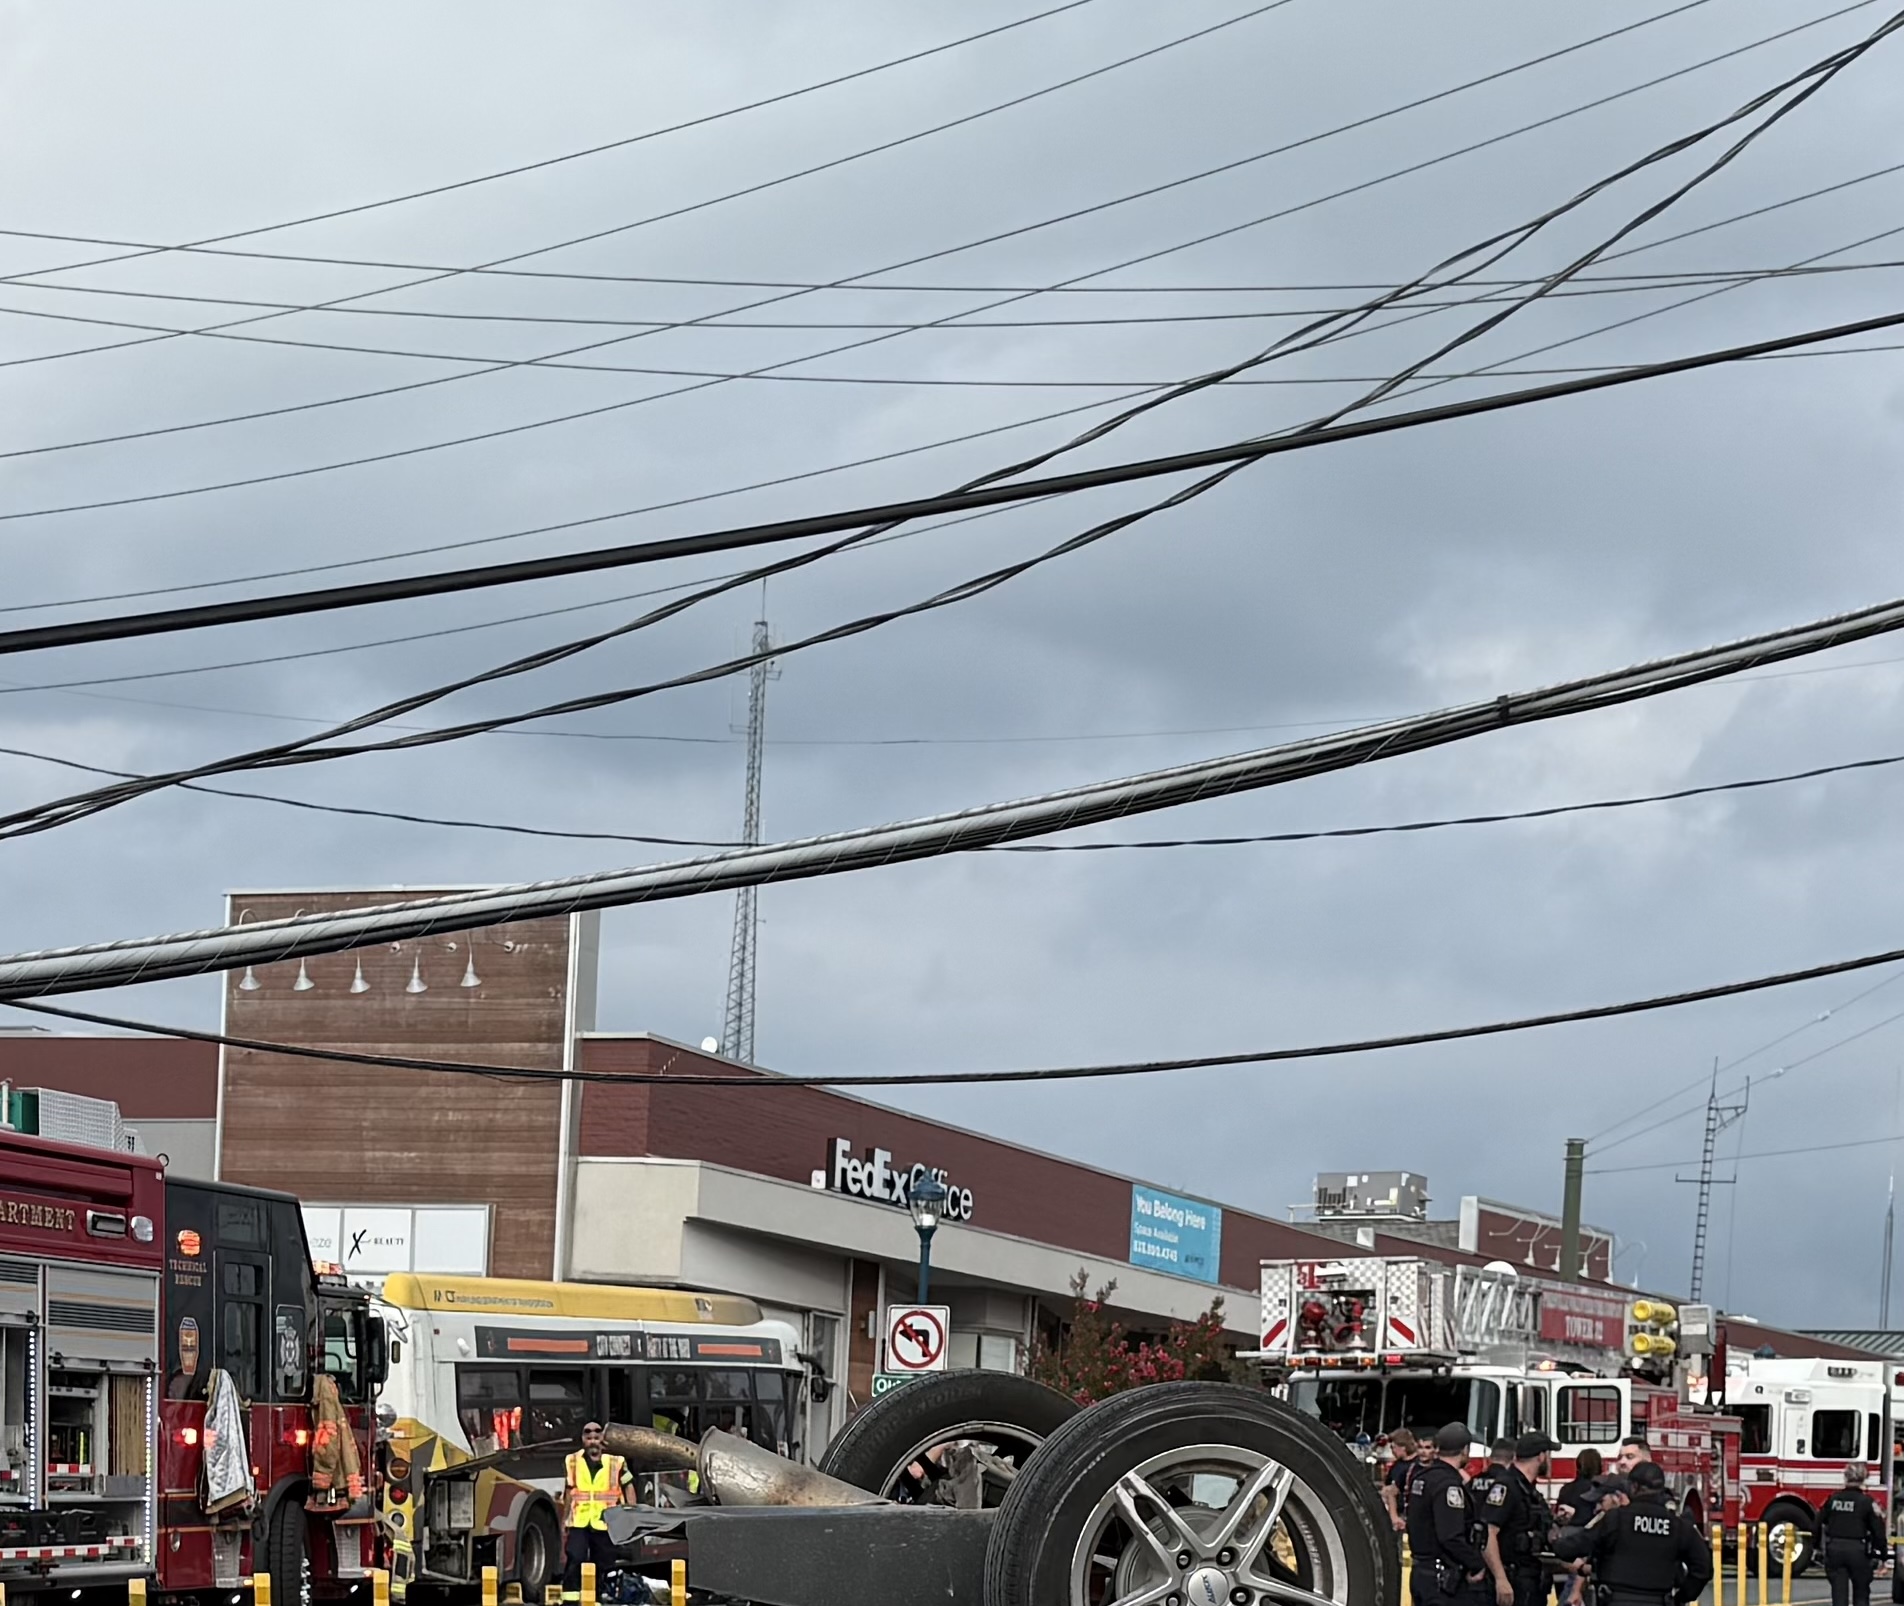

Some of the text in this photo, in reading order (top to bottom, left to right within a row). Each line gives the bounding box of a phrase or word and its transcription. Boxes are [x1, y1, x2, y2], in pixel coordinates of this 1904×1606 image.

[834, 1137, 908, 1205] FedEx
[1831, 1500, 1854, 1512] POLICE
[1634, 1515, 1670, 1535] POLICE
